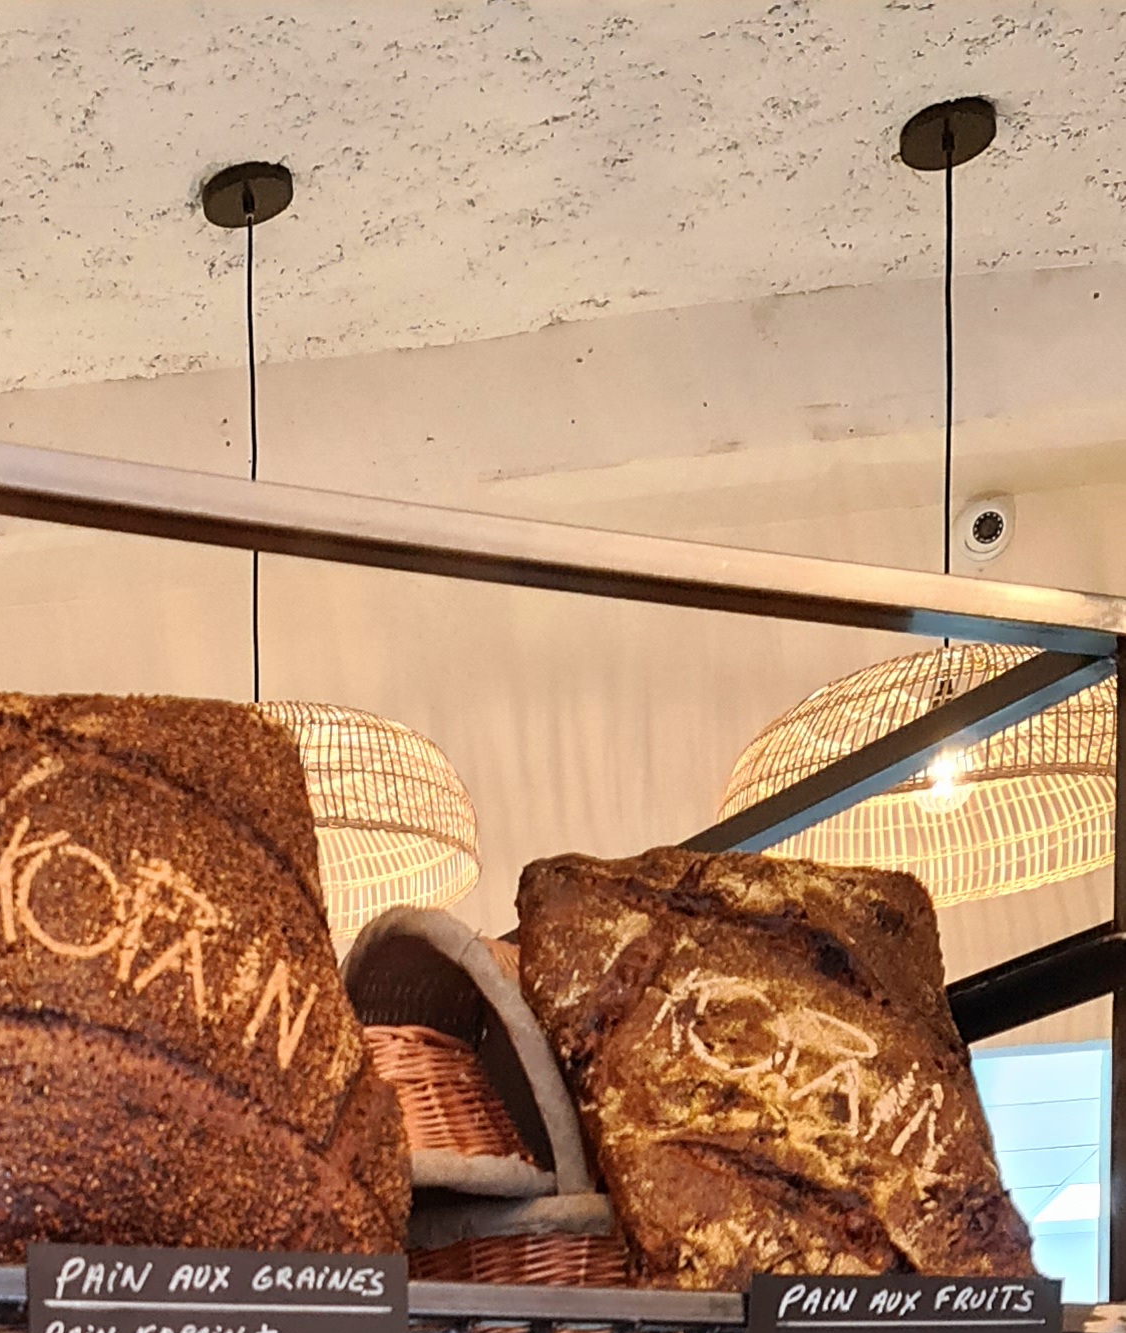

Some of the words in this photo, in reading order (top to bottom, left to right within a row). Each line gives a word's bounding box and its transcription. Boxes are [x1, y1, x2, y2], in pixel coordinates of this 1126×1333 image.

[54, 1257, 153, 1299] PAIN
[168, 1264, 231, 1292] AUX
[251, 1264, 386, 1297] GRAINES
[777, 1283, 858, 1319] PAIN
[868, 1289, 922, 1316] AUX
[933, 1284, 1035, 1313] FRUITS
